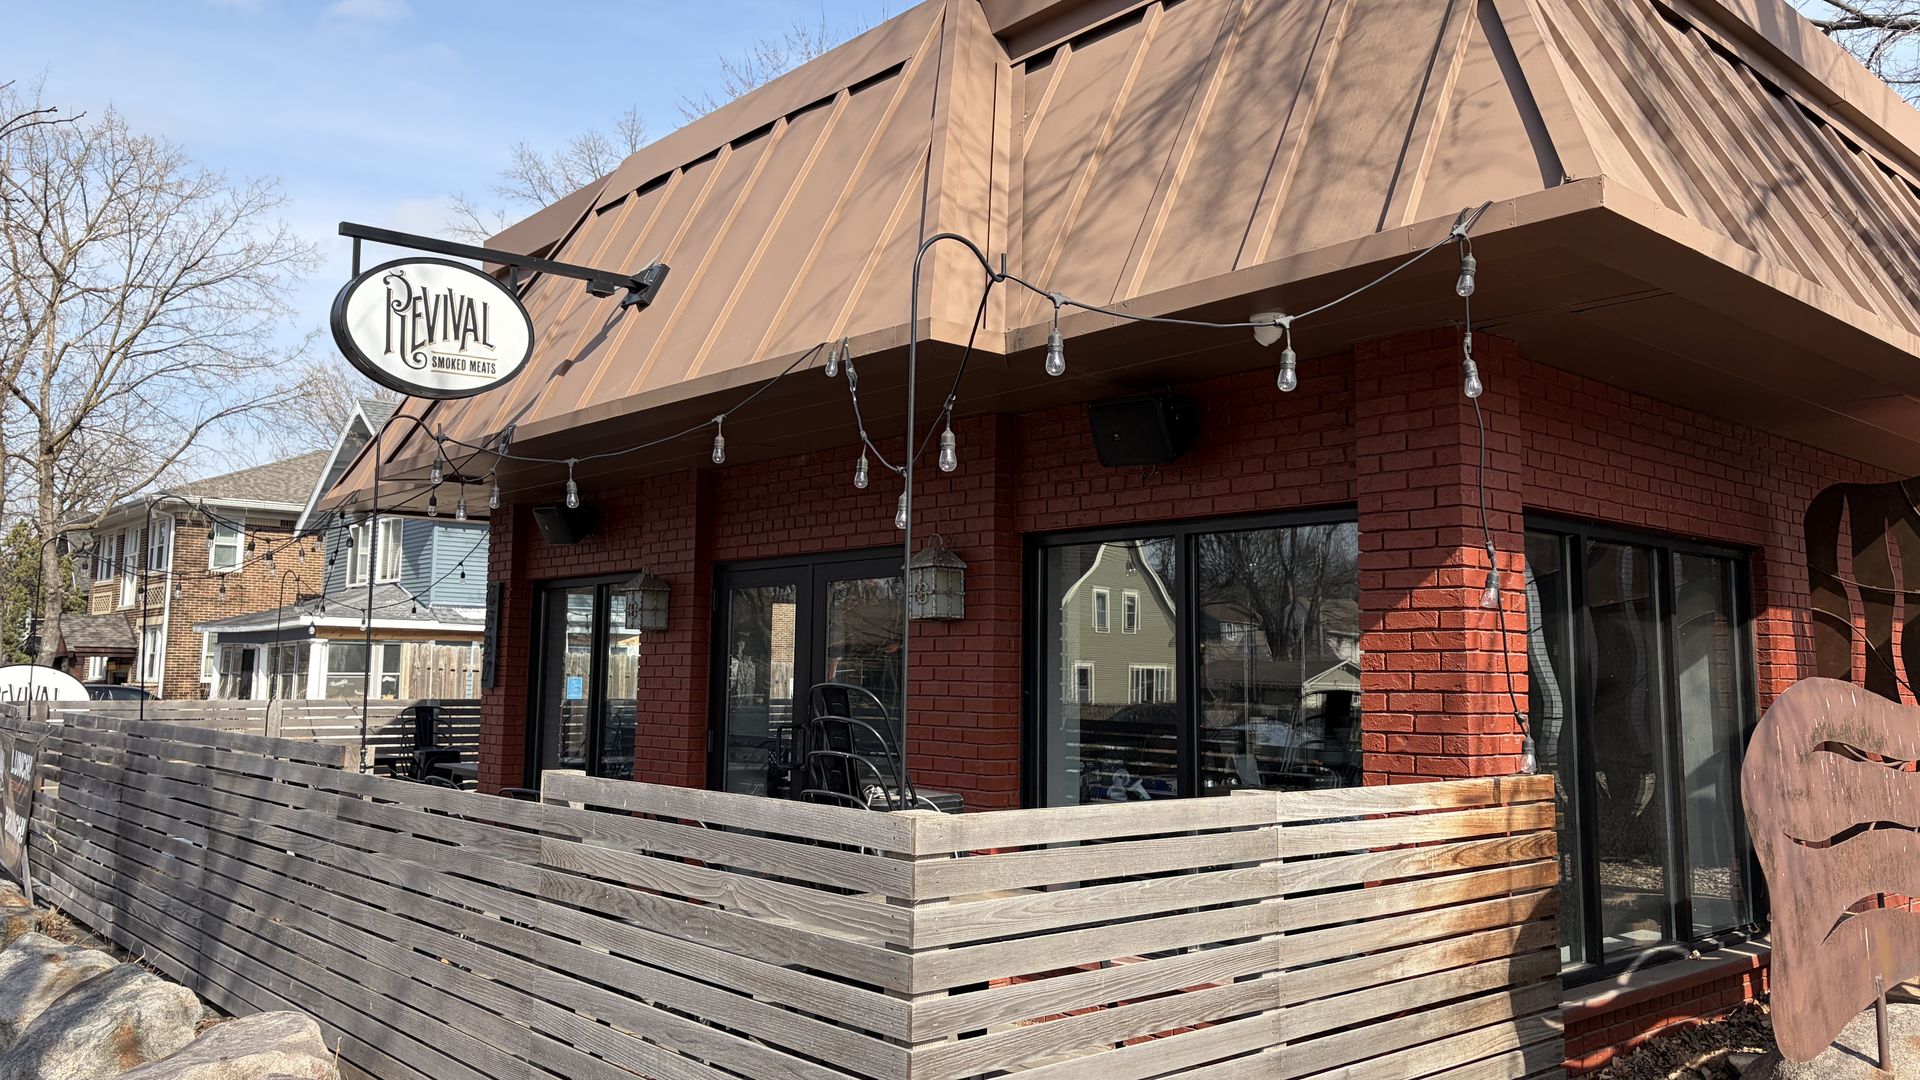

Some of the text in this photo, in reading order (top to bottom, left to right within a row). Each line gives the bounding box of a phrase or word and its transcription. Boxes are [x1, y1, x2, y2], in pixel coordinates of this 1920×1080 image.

[383, 270, 495, 369] REVIVAL
[432, 355, 497, 374] SMOKED MEATS
